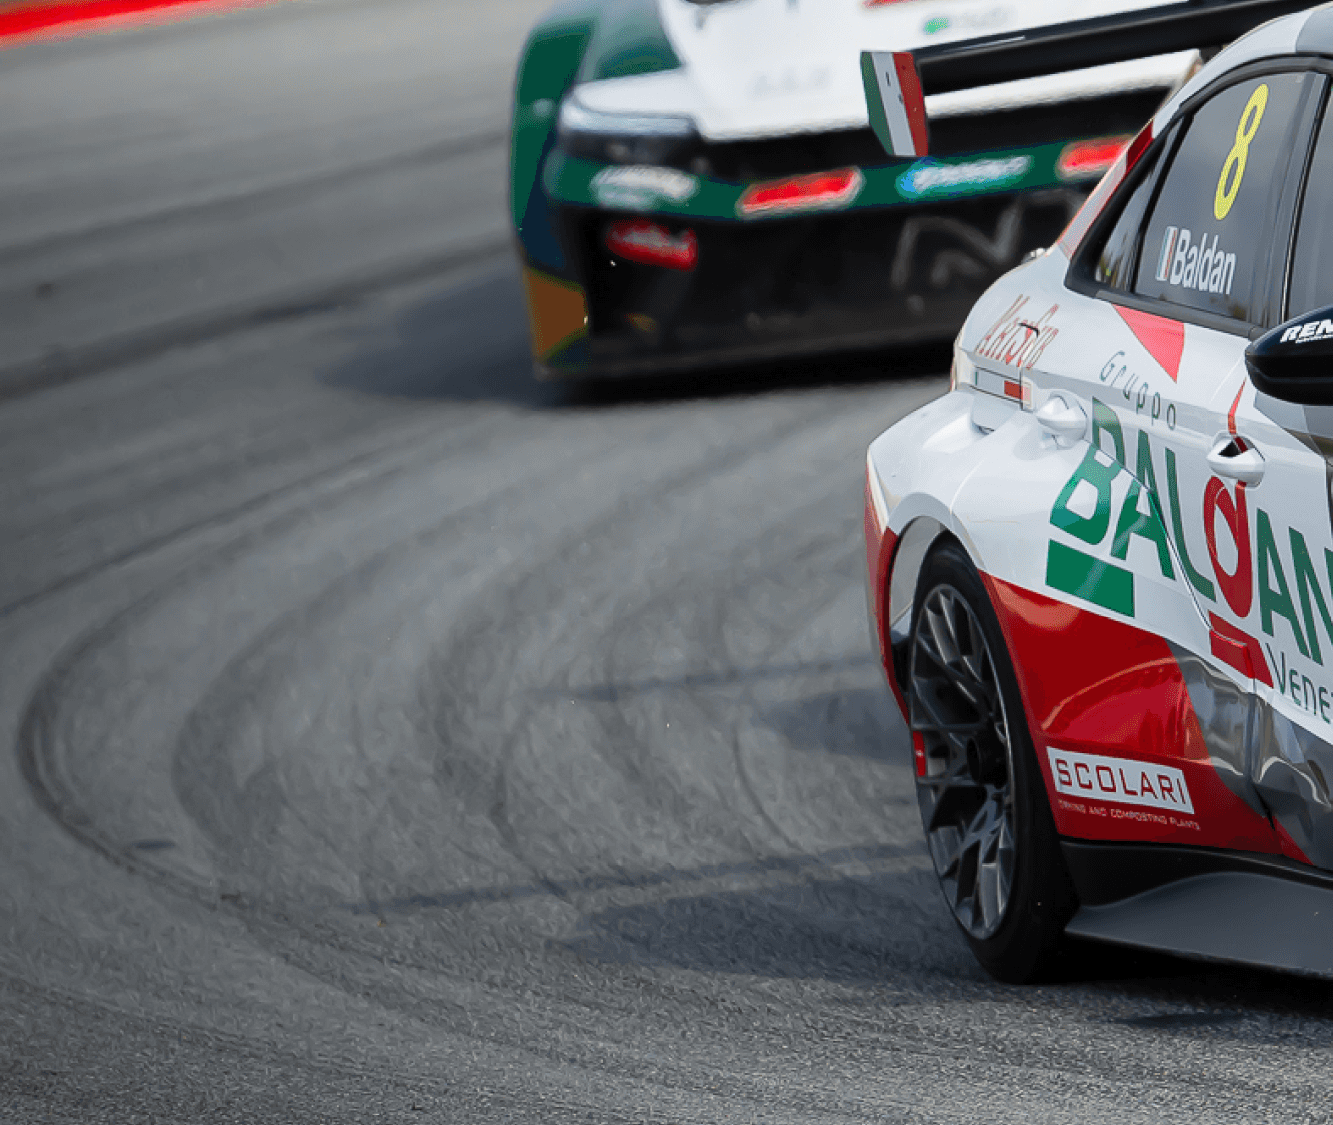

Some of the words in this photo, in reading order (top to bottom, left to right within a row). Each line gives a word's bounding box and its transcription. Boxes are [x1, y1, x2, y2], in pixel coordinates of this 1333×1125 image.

[1213, 83, 1269, 221] 8
[1171, 227, 1236, 295] Baldan
[1099, 350, 1177, 431] Gruppo
[1054, 757, 1187, 805] SCOLARI
